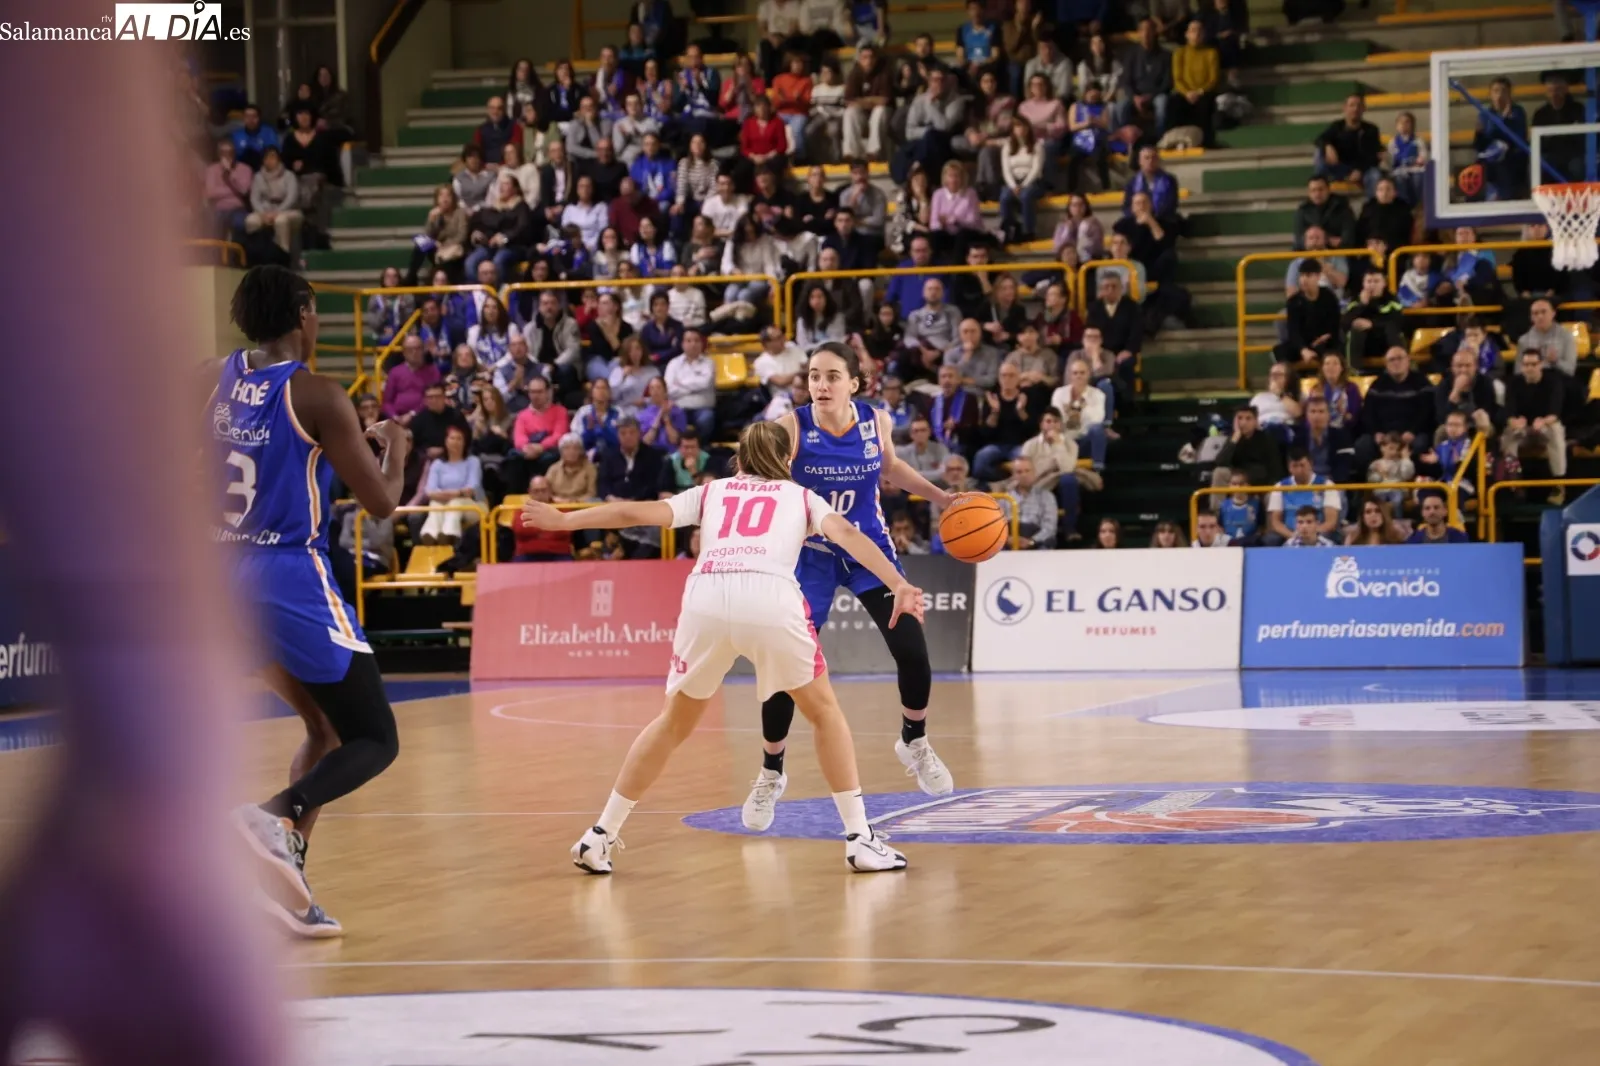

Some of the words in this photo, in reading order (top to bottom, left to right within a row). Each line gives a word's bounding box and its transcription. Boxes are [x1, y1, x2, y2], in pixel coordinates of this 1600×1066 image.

[804, 465, 852, 475] CASTILLA
[853, 465, 861, 475] Y
[836, 474, 866, 482] IMPULSA
[223, 450, 257, 528] 3
[725, 481, 782, 493] MATAIX
[829, 489, 856, 516] 10
[718, 496, 777, 540] 10
[706, 545, 767, 559] reganosa
[715, 560, 745, 568] XUNTA
[1045, 589, 1085, 613] EL
[1097, 586, 1228, 613] GANSO
[519, 621, 616, 646] Elizabeth
[1085, 625, 1157, 637] PERFUMES
[1257, 618, 1505, 643] perfumeriasavenida.com
